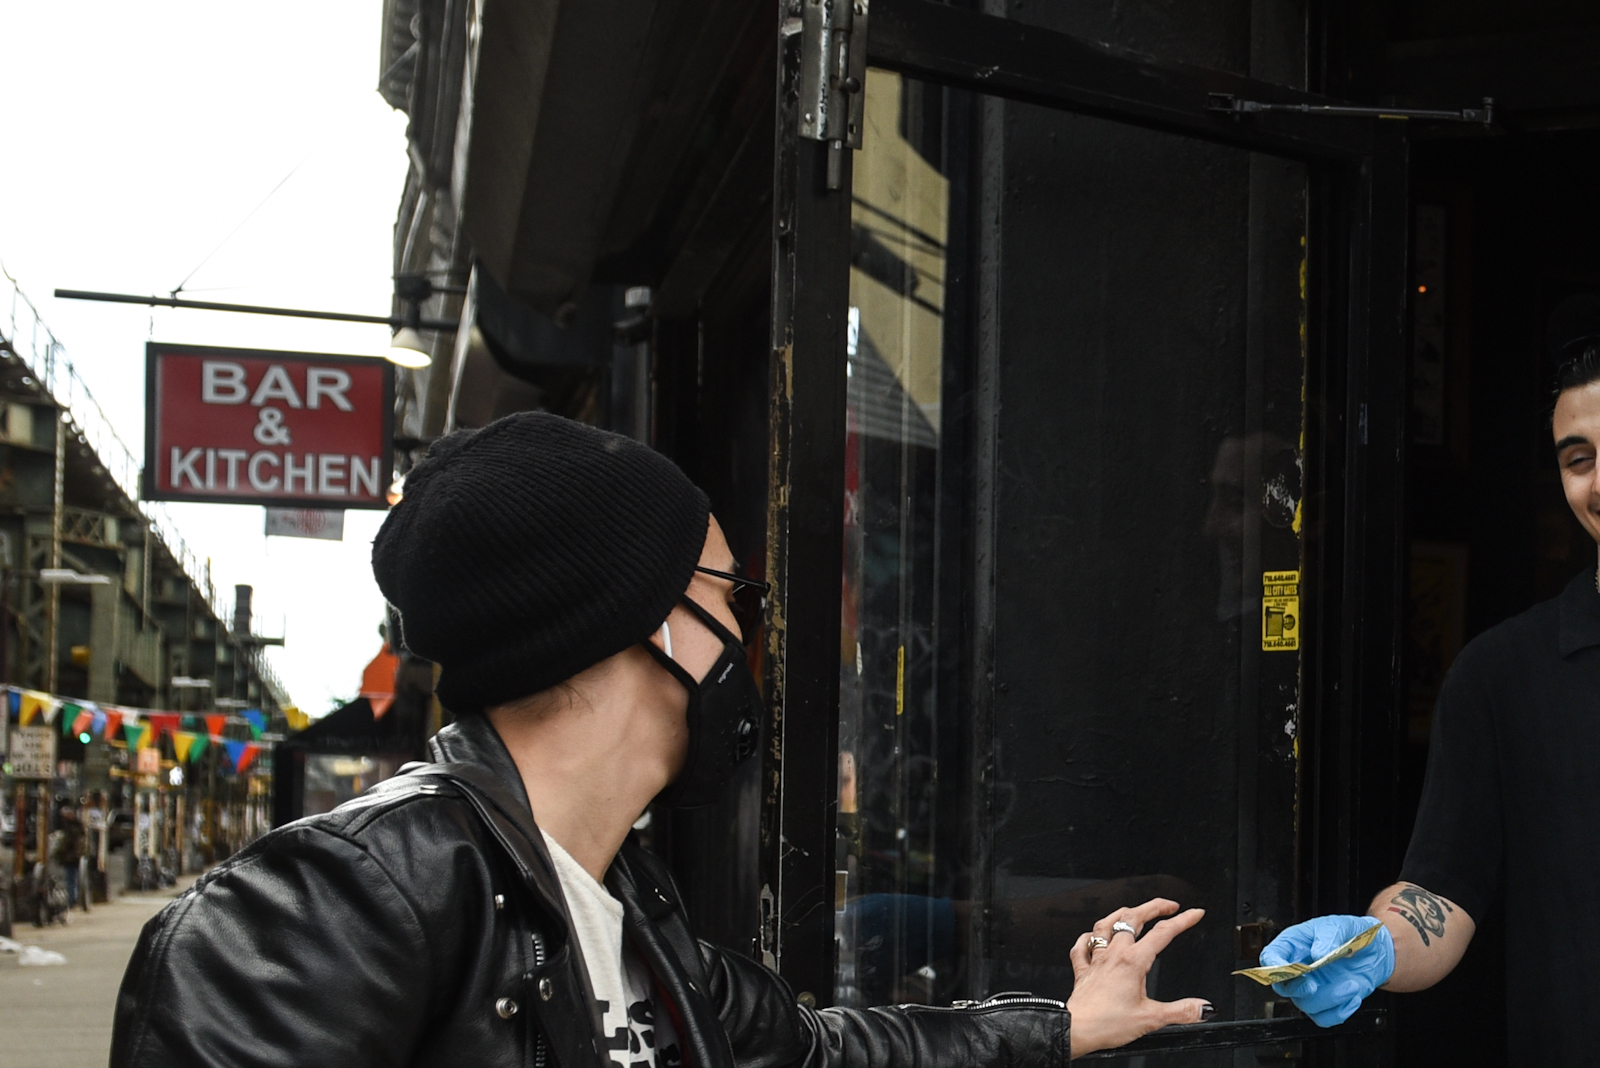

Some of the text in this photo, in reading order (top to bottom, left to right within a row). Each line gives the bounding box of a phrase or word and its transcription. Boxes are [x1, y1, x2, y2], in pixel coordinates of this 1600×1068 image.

[201, 360, 355, 412] BAR
[253, 406, 293, 446] &
[169, 446, 381, 497] KITCHEN
